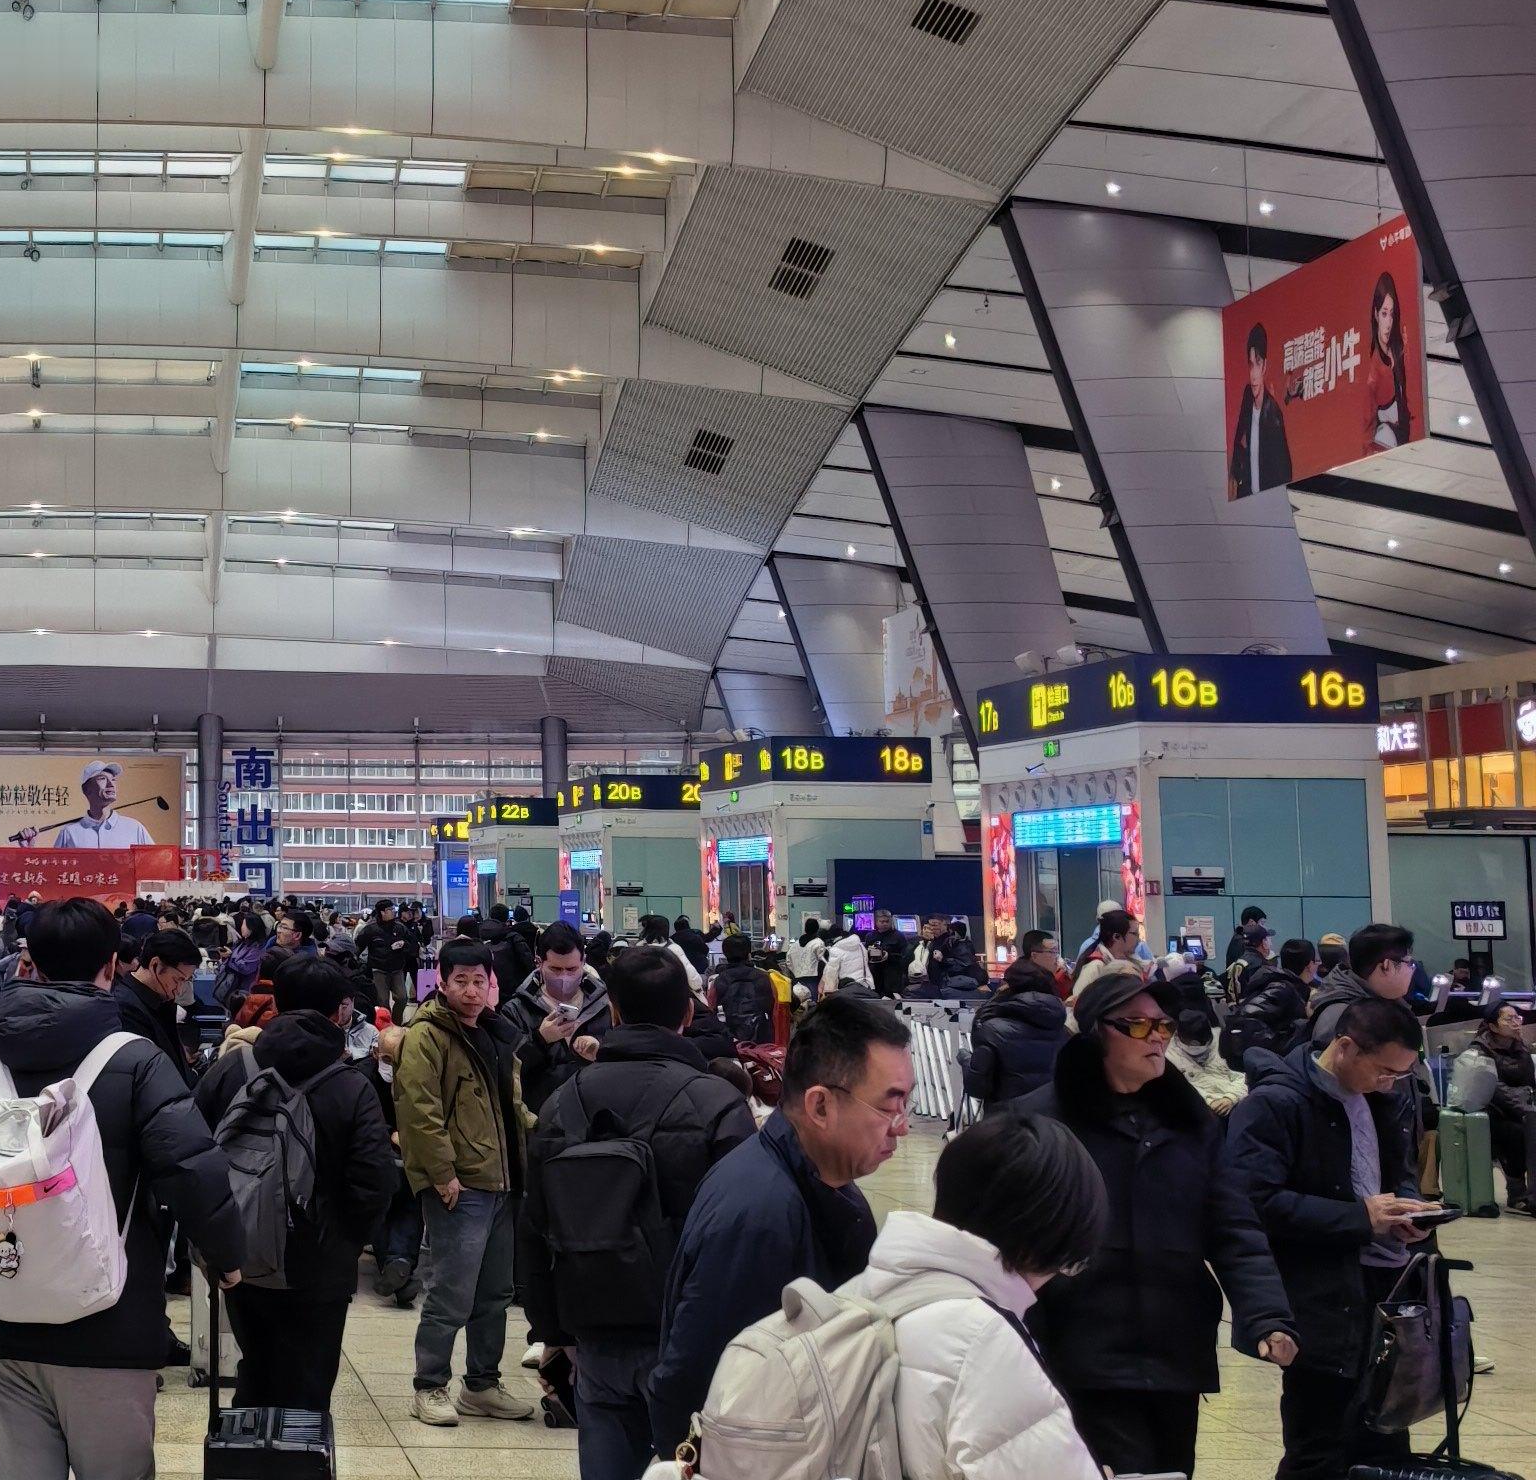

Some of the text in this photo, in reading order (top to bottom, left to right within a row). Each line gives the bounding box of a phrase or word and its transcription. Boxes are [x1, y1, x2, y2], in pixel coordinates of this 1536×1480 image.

[1325, 326, 1362, 392] 小牛
[1109, 672, 1135, 708] 16B
[1151, 669, 1219, 707] 16B
[1300, 670, 1365, 707] 16B
[979, 700, 999, 733] 17B
[781, 746, 825, 770] 18B
[880, 746, 923, 771] 18B
[218, 781, 231, 832] South
[607, 783, 642, 800] 20B
[232, 747, 275, 898] 南出口
[501, 804, 530, 819] 22B
